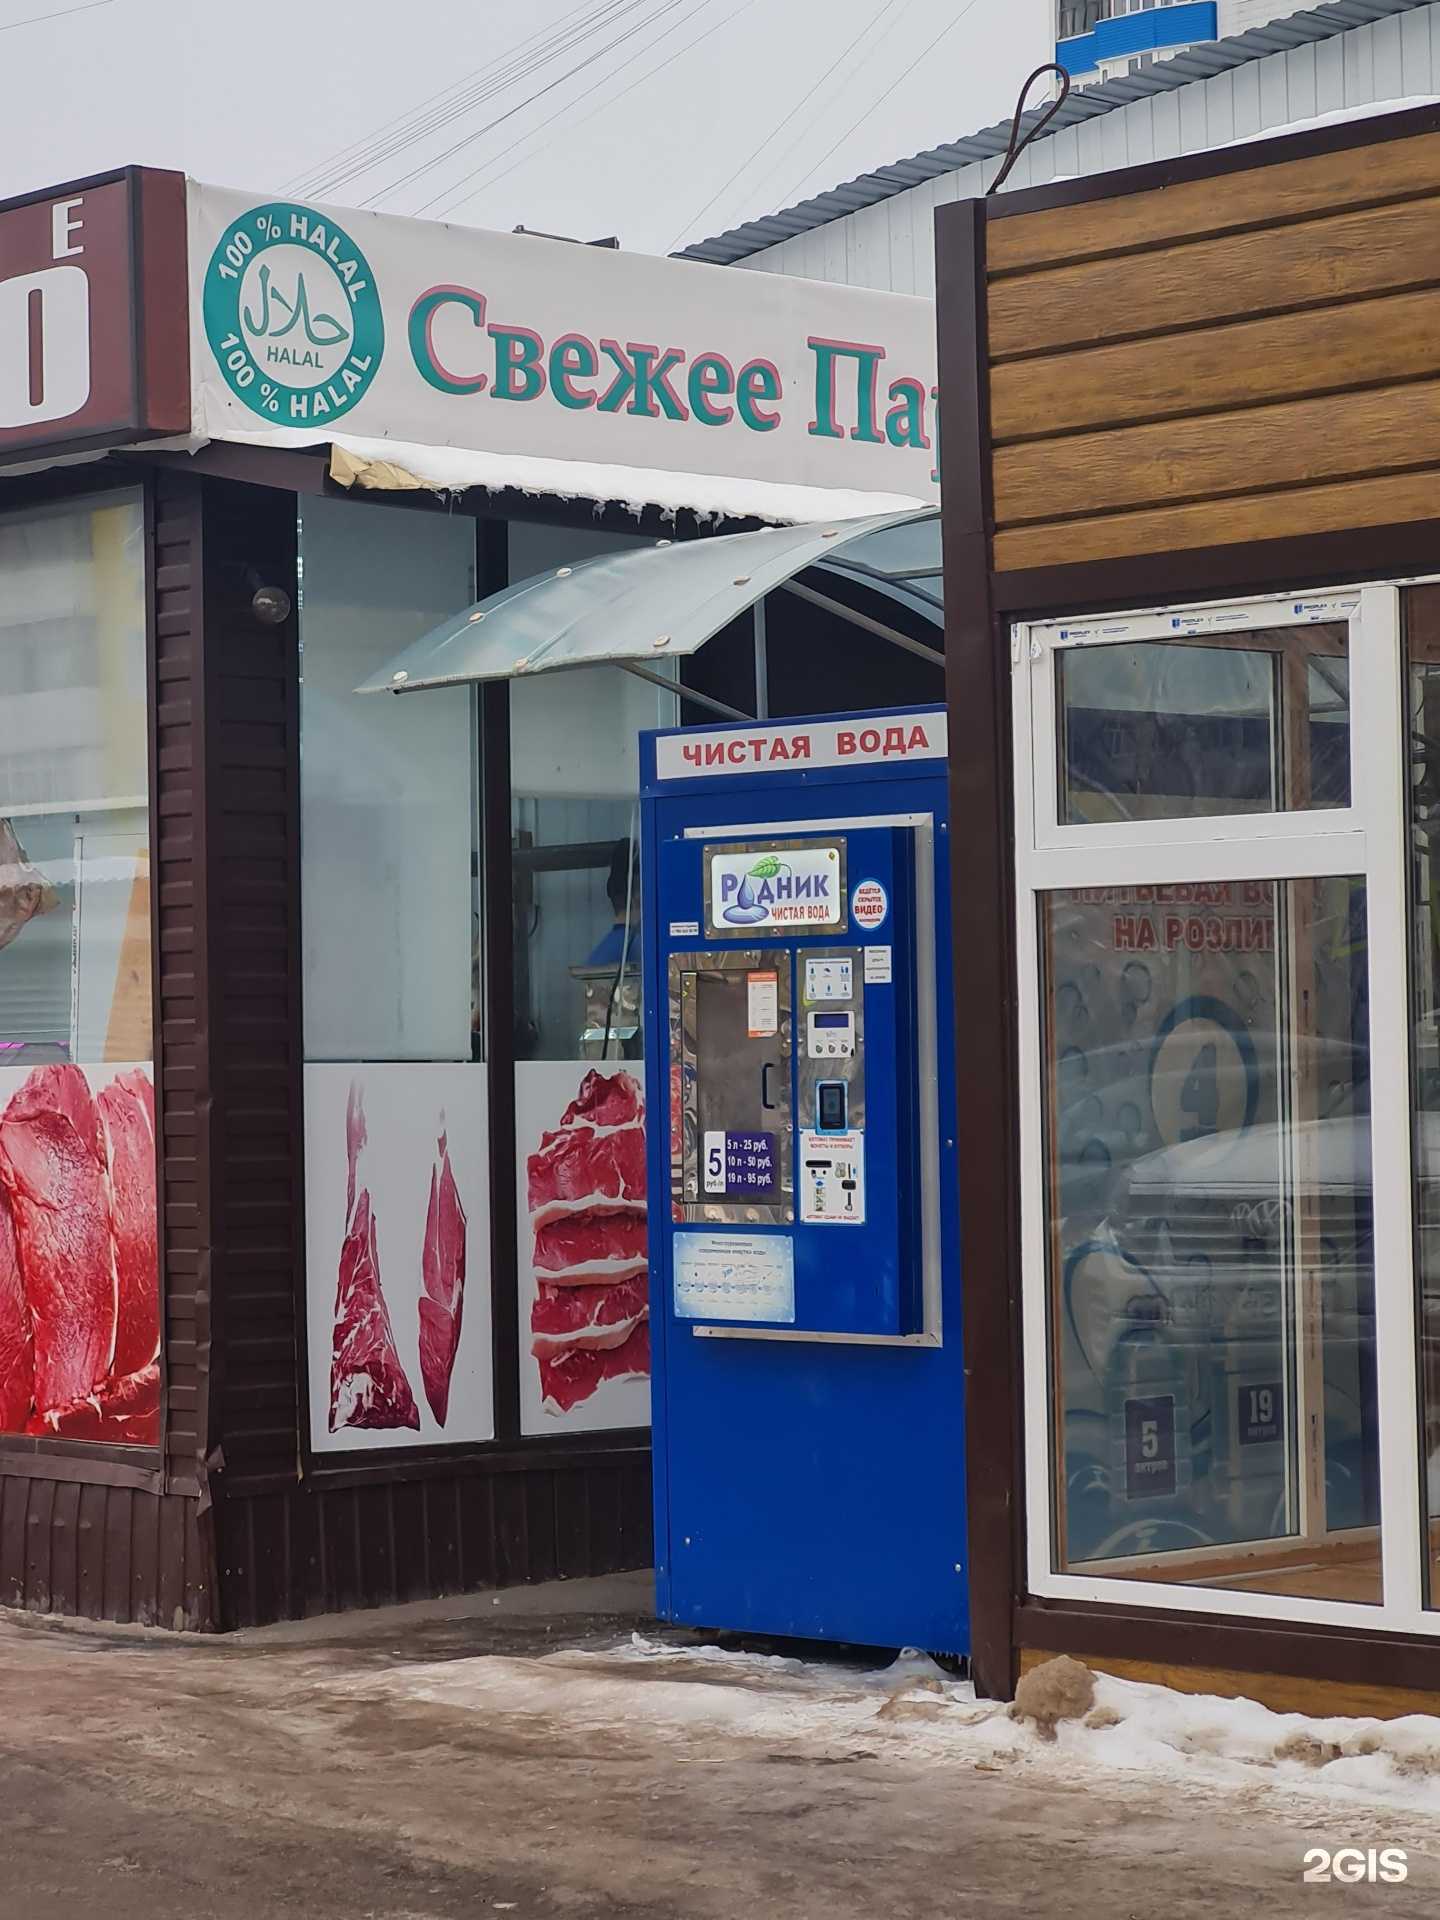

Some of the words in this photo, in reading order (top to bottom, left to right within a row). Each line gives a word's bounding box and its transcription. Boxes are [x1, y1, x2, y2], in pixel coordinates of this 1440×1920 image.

[218, 231, 253, 280] 100
[256, 214, 282, 242] %
[290, 214, 366, 303] HALAL
[266, 345, 325, 369] HALAL
[220, 332, 255, 388] 100
[260, 383, 280, 412] %
[290, 354, 373, 418] HALAL
[407, 283, 783, 432] Свежее
[806, 335, 940, 483] Па
[682, 735, 811, 767] ЧИСТАЯ
[836, 725, 930, 756] ВОДА
[771, 906, 806, 921] ЧИСТАЯ
[807, 905, 830, 921] ВОДА
[854, 904, 883, 916] ВИДЕО
[1114, 917, 1156, 949] НА
[727, 1139, 732, 1150] 5
[743, 1139, 752, 1150] 25
[753, 1139, 768, 1153] руб.
[709, 1148, 722, 1177] 5
[727, 1156, 736, 1166] 10
[747, 1156, 756, 1167] 50
[757, 1156, 773, 1169] руб.
[727, 1172, 736, 1183] 19
[757, 1173, 773, 1186] руб.
[1249, 1389, 1273, 1424] 19
[1141, 1420, 1159, 1458] 5
